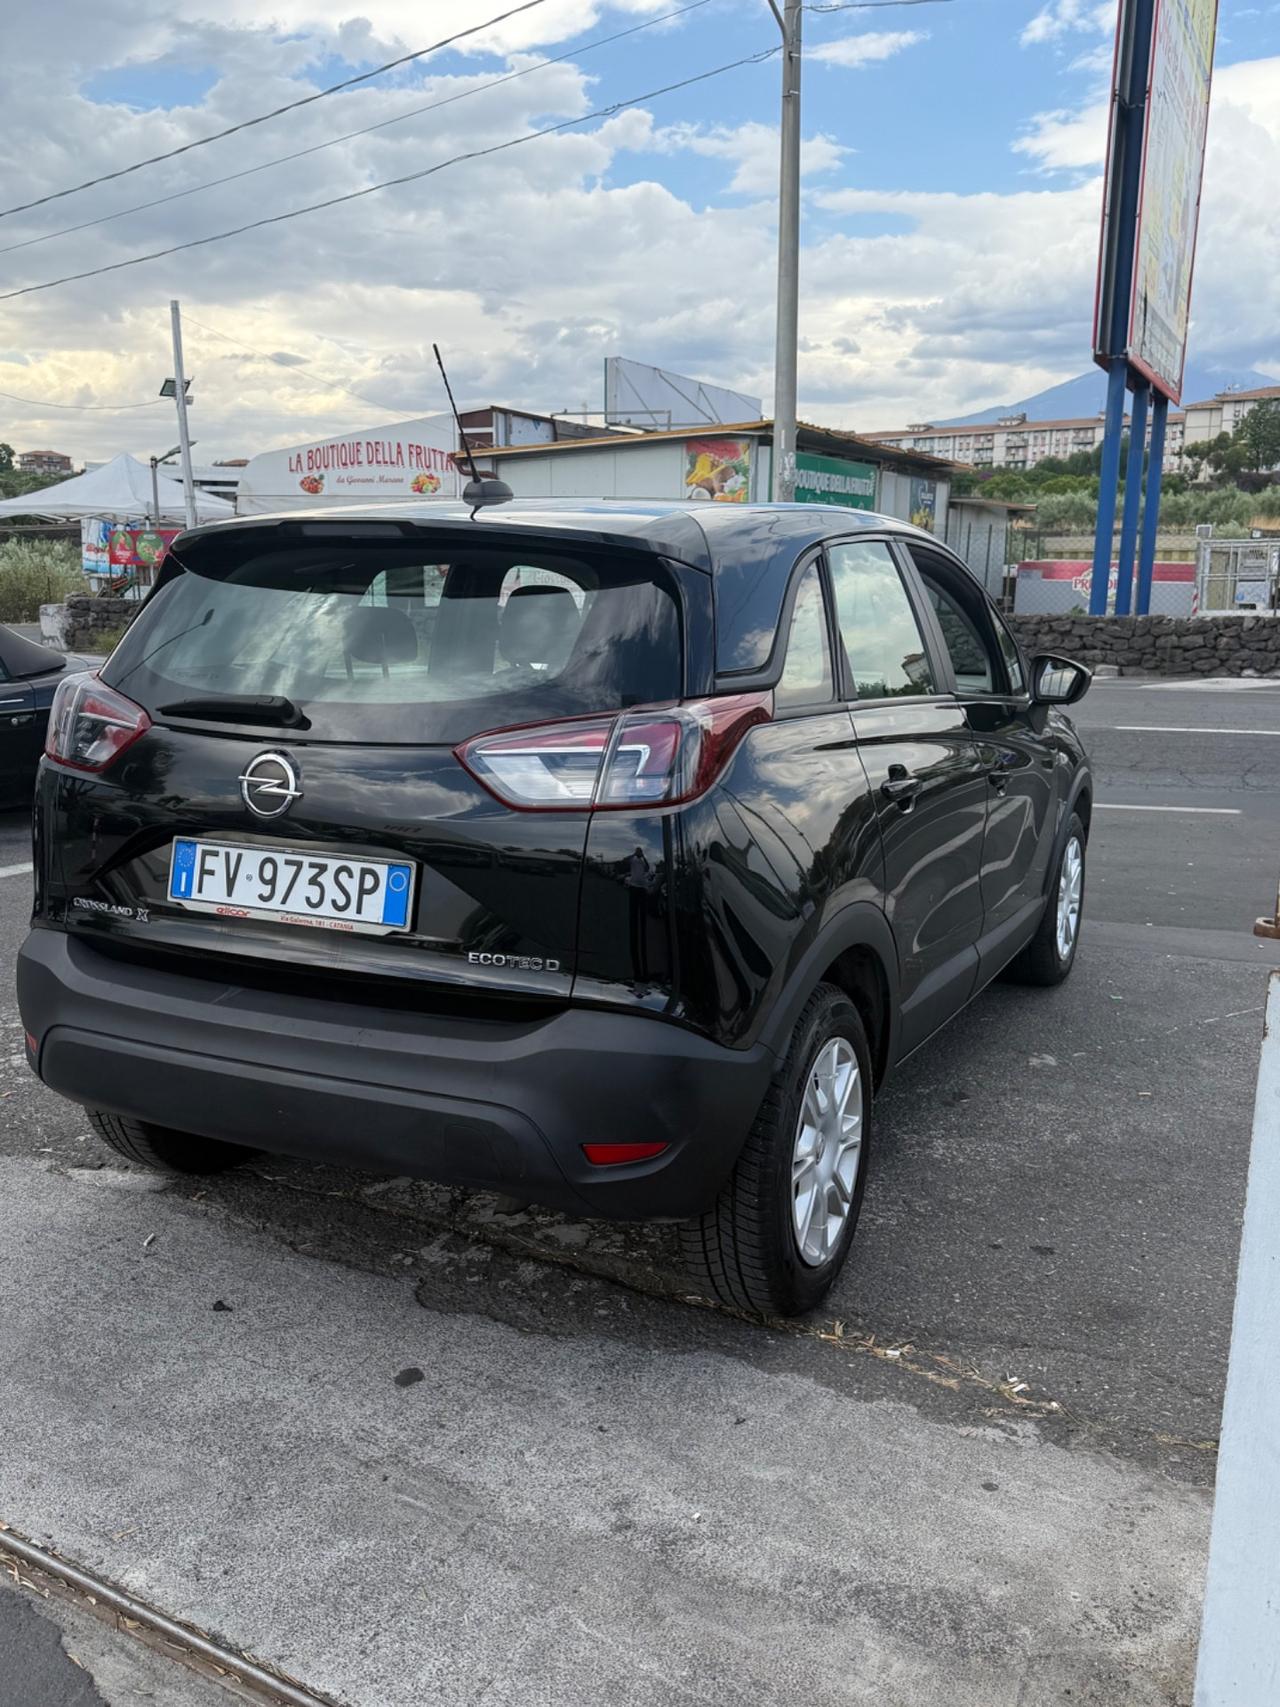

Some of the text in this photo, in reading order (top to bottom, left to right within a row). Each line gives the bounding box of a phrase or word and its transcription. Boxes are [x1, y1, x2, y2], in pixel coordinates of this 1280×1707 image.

[289, 441, 454, 473] LA BOUTIQUE DELLA FRUTTA
[197, 849, 380, 915] FV 973SP
[73, 897, 150, 922] CROSSLAND X
[468, 951, 560, 971] ECOTEC D
